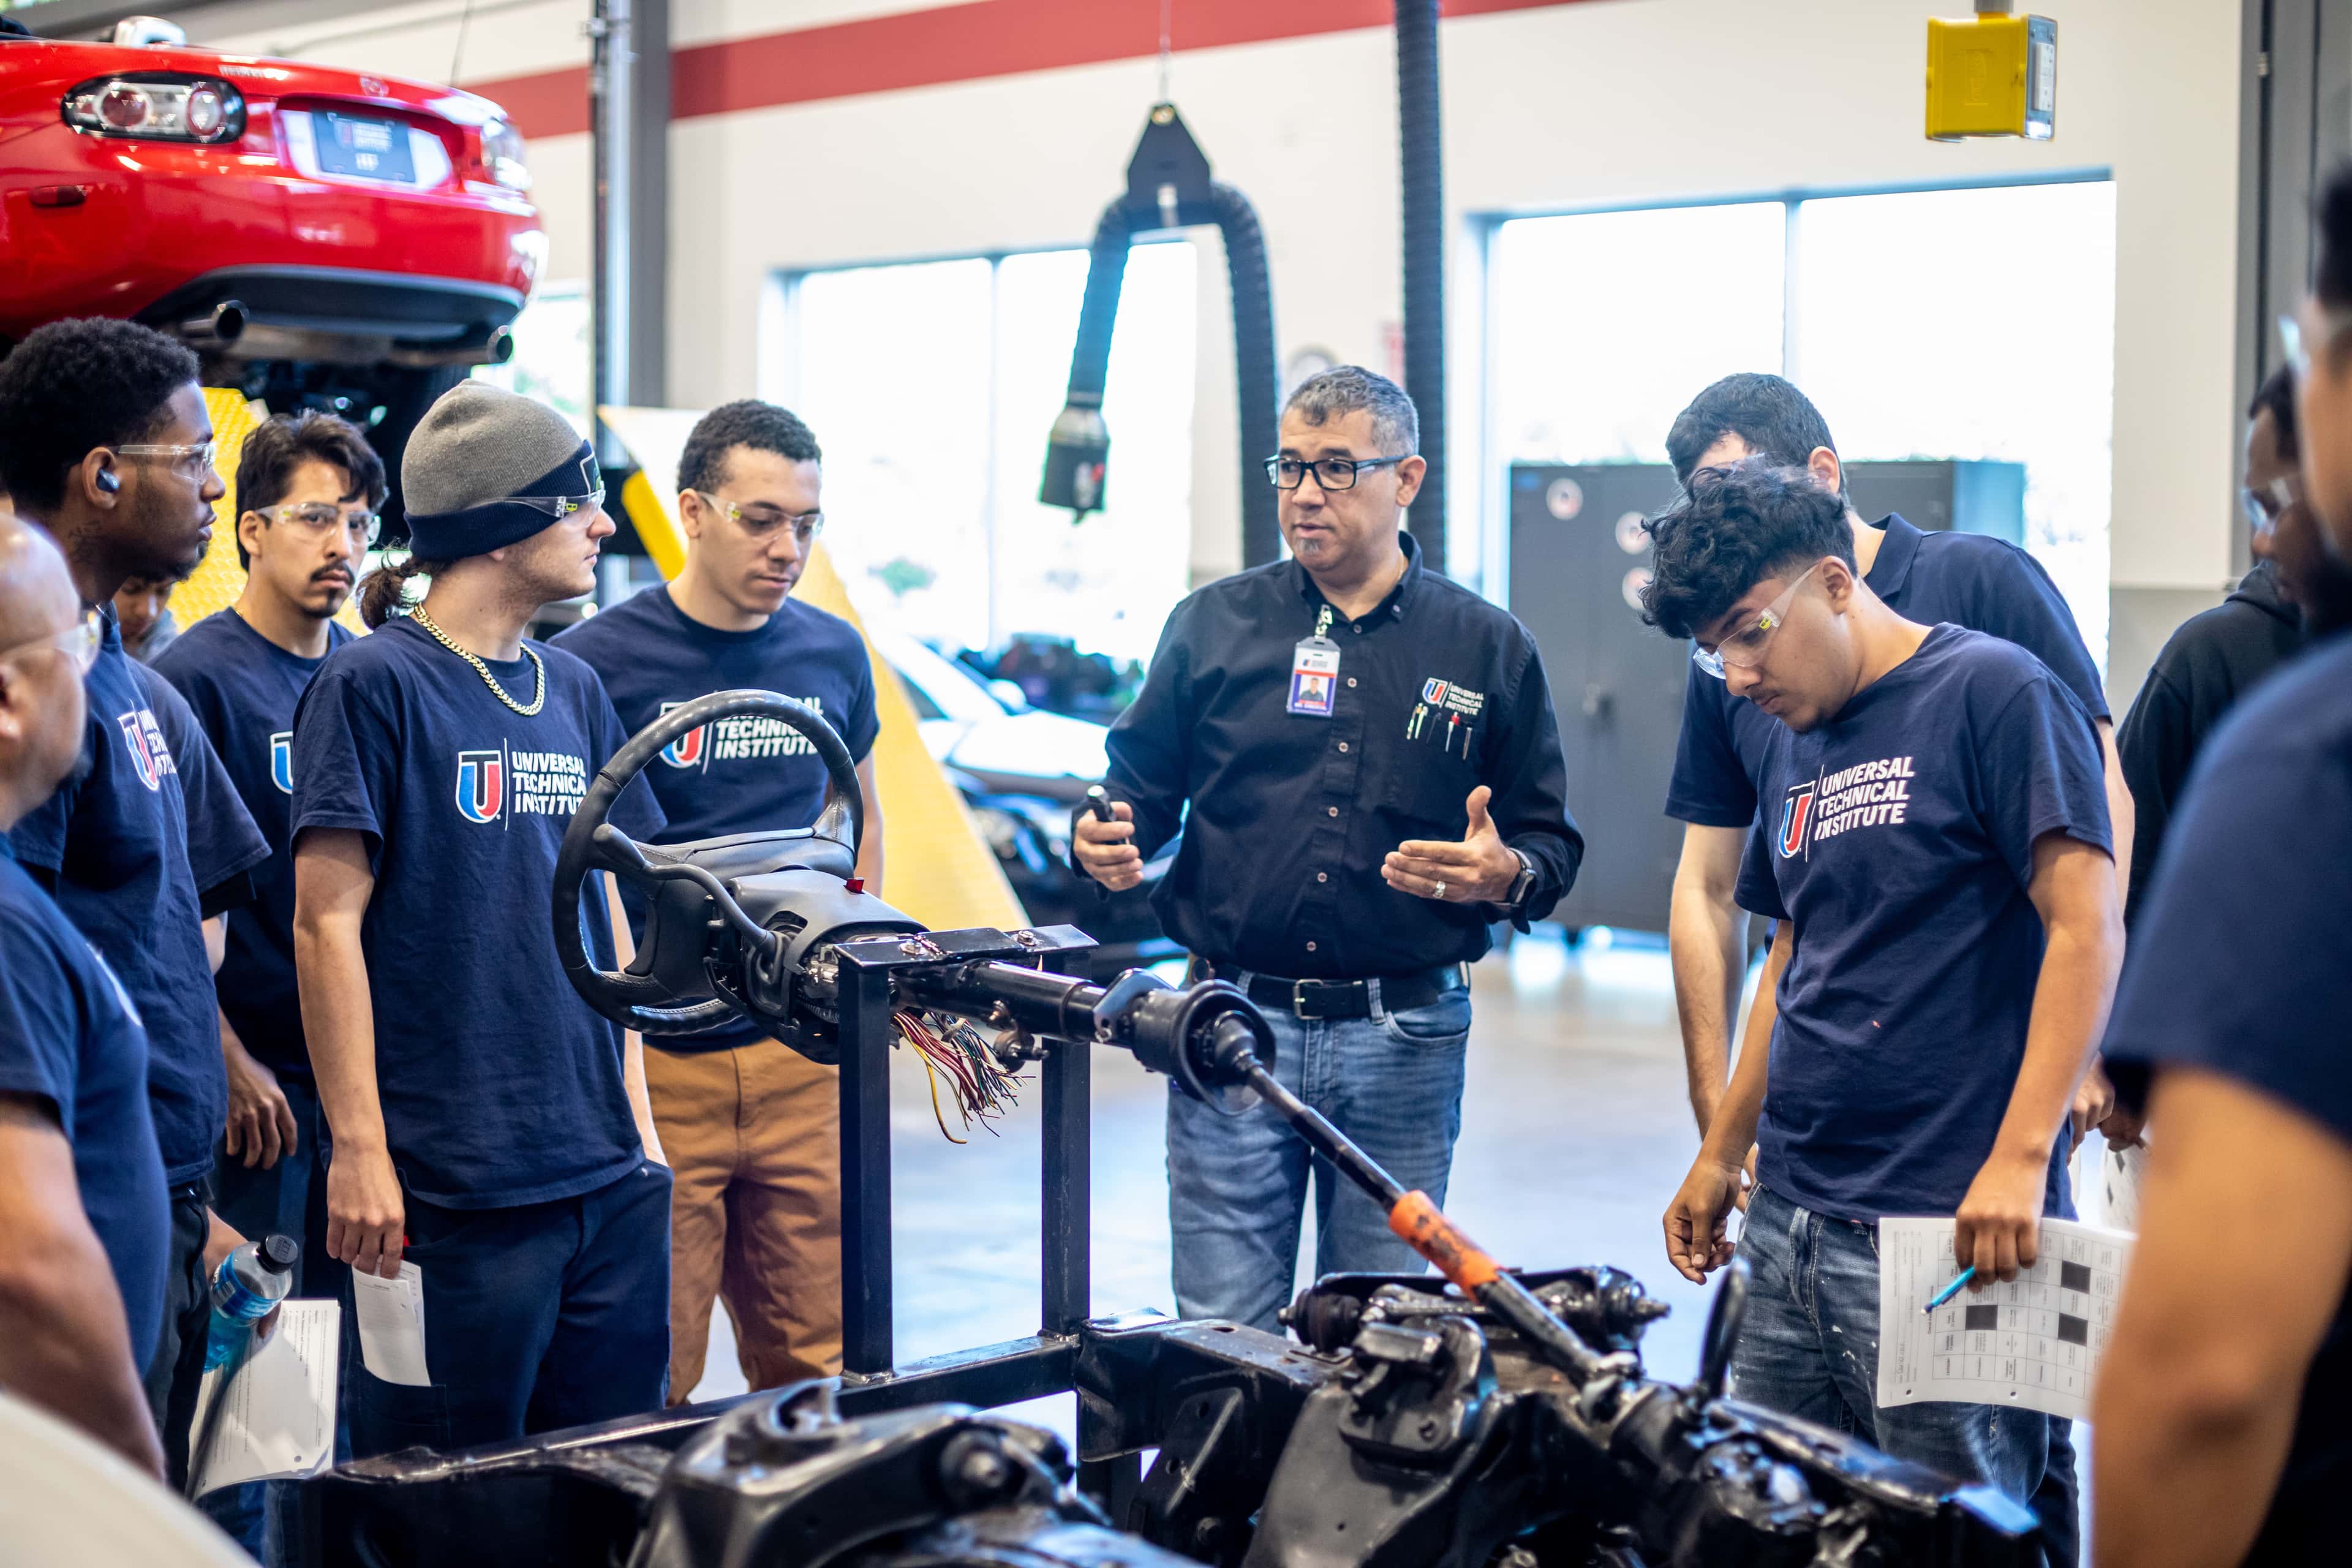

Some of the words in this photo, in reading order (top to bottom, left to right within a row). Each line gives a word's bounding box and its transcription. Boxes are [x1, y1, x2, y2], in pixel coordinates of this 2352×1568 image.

[716, 718, 804, 740] TECHNI
[512, 752, 586, 777] UNIVERSAL
[1821, 756, 1915, 796] UNIVERSAL
[512, 772, 587, 796] TECHNICA
[514, 795, 584, 815] INSTITU
[1818, 780, 1910, 819] TECHNICAL
[1814, 803, 1907, 841] INSTITUTE
